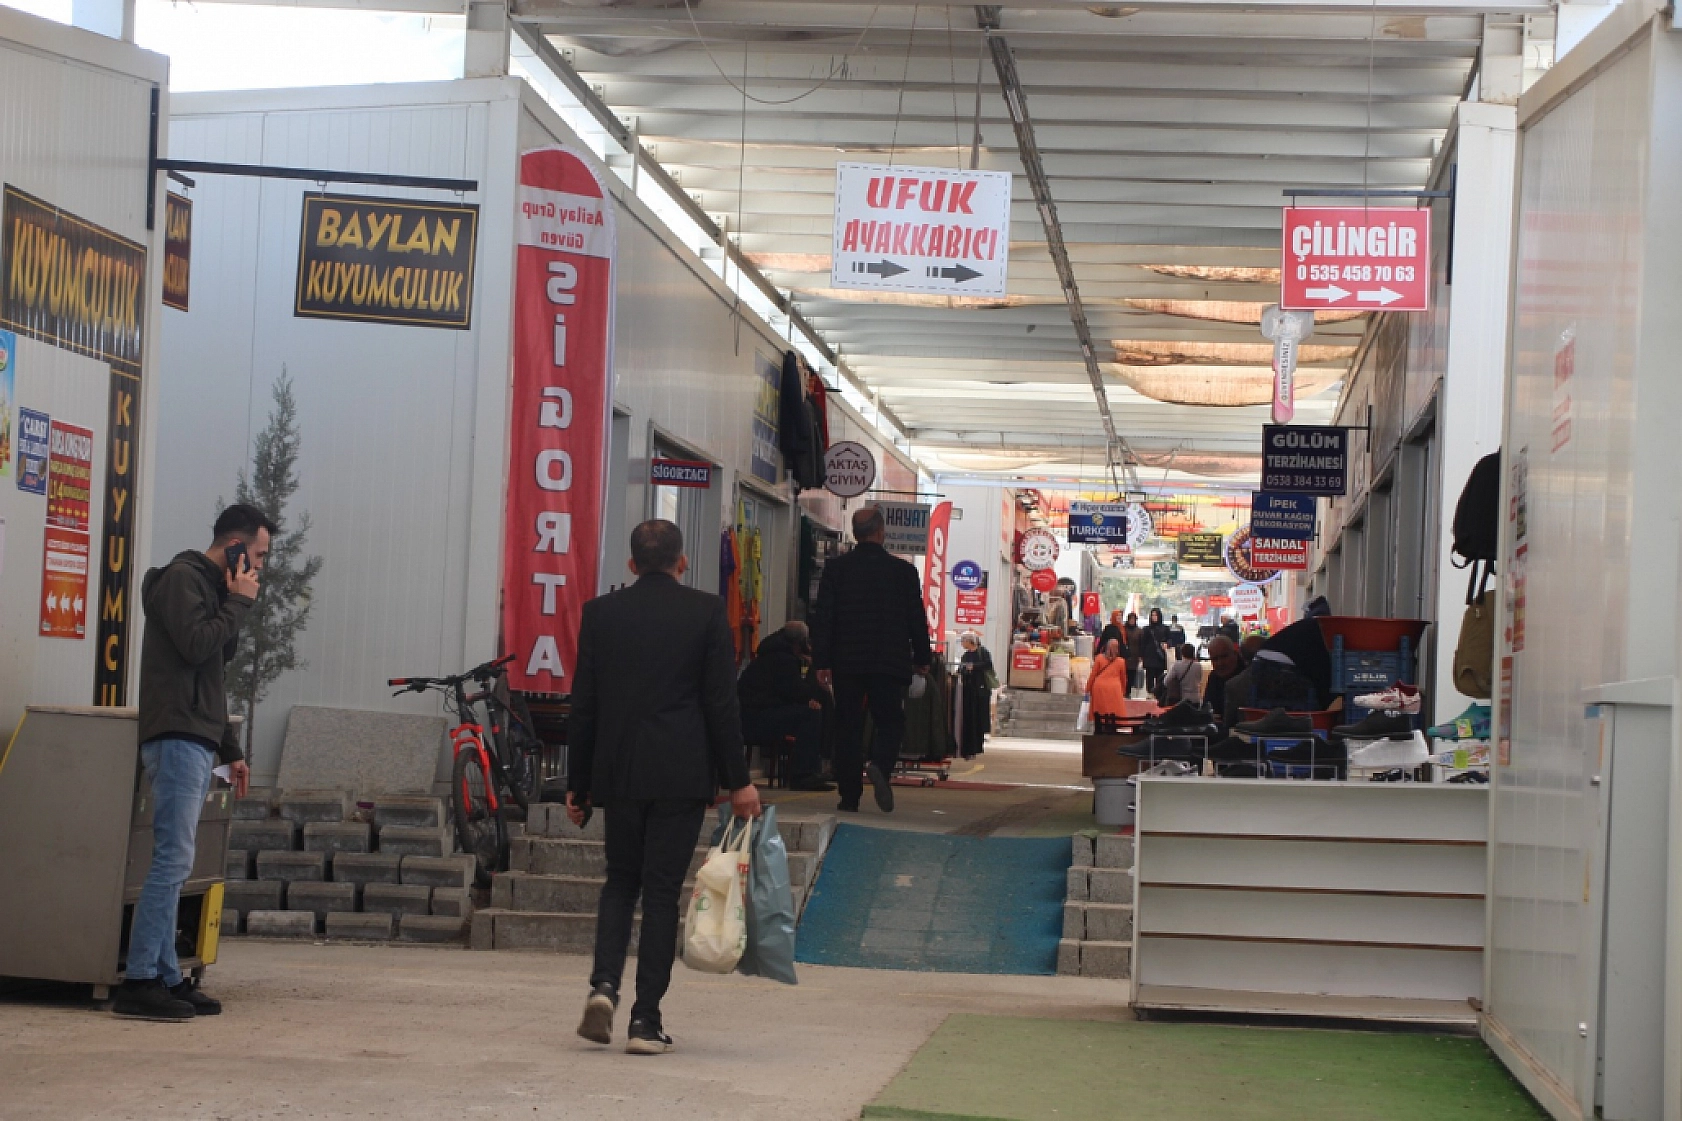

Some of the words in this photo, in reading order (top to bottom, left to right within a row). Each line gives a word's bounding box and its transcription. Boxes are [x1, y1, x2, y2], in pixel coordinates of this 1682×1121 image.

[866, 176, 978, 214] UFUK
[316, 208, 462, 257] BAYLAN
[842, 218, 998, 260] AYAKKABICI
[1292, 220, 1417, 262] ÇİLİNGİR
[10, 216, 140, 339] KUYUMCULUK
[1297, 265, 1307, 281] 0
[1310, 265, 1340, 281] 535
[1342, 265, 1372, 281] 458
[1375, 266, 1392, 281] 70
[1395, 266, 1415, 282] 63
[306, 260, 463, 313] KUYUMCULUK
[1272, 431, 1340, 449] GÜLÜM
[827, 460, 869, 472] AKTAŞ
[1266, 453, 1343, 470] TERZİHANESİ
[653, 464, 709, 481] SİGORTACI
[829, 474, 866, 486] GİYİM
[1293, 476, 1312, 487] 384
[1313, 477, 1326, 487] 33
[1328, 477, 1341, 488] 69
[1269, 497, 1297, 509] İPEK
[886, 508, 929, 528] HAYAT
[1070, 525, 1124, 537] TURKCELL
[1255, 537, 1305, 550] SANDAL
[1254, 551, 1305, 563] TERZİHANESİ
